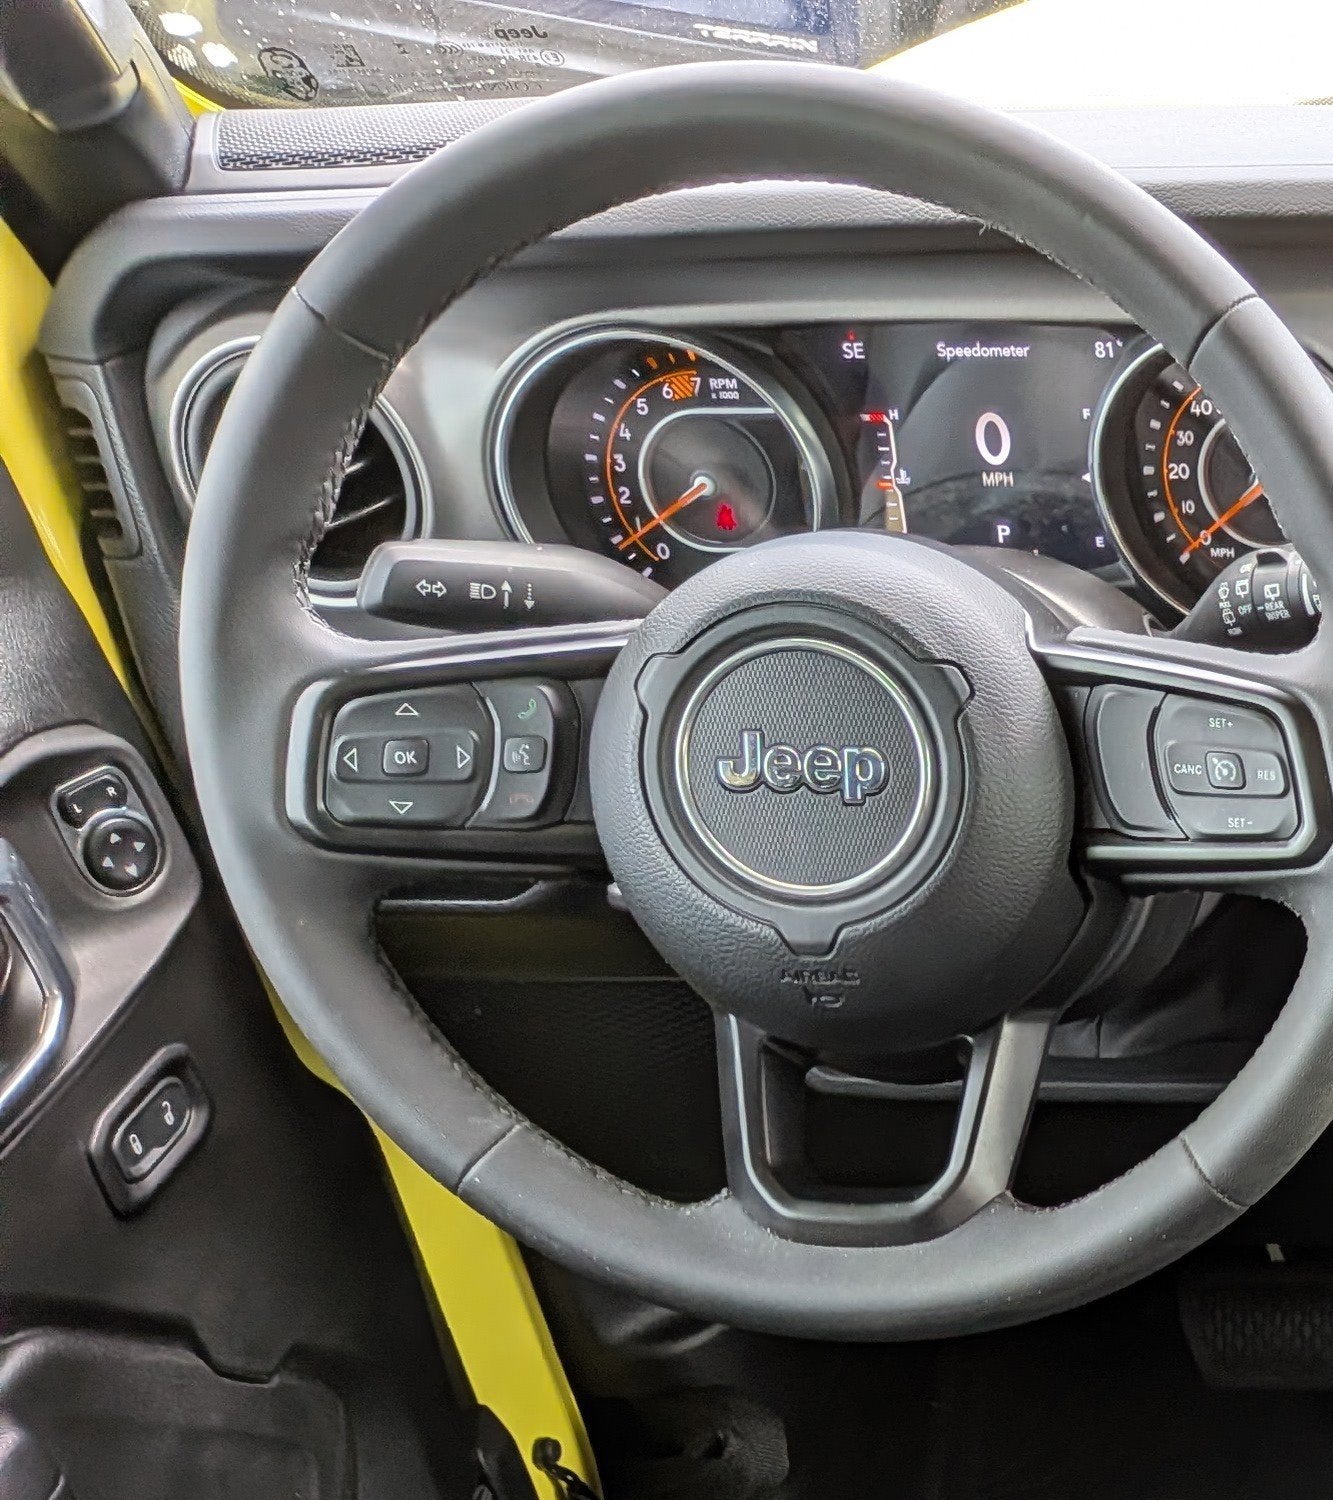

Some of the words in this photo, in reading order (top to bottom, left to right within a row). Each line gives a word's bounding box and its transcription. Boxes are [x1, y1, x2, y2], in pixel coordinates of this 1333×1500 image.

[842, 341, 866, 360] SE
[936, 341, 1030, 362] Speedometer
[662, 383, 673, 399] 6
[691, 378, 701, 396] 7
[709, 378, 738, 390] RPM
[636, 398, 649, 416] 5
[888, 409, 899, 421] H
[1082, 408, 1091, 420] F
[1190, 400, 1214, 417] 40
[619, 423, 631, 441] 4
[975, 412, 1011, 466] 0
[1176, 431, 1194, 447] 30
[613, 454, 626, 472] 3
[982, 471, 1014, 488] MPH
[1168, 463, 1190, 480] 20
[619, 487, 631, 505] 2
[1181, 500, 1195, 514] 10
[997, 524, 1011, 544] P
[1095, 536, 1105, 548] E
[1199, 530, 1212, 546] 0
[656, 542, 670, 560] 0
[1210, 547, 1235, 558] MPH
[1238, 604, 1252, 616] OFF
[1264, 600, 1285, 611] REAR
[394, 750, 418, 765] OK
[716, 729, 890, 804] Jeep
[1173, 763, 1203, 776] CANC
[1257, 770, 1276, 781] RES
[106, 786, 118, 798] R
[72, 803, 83, 814] L
